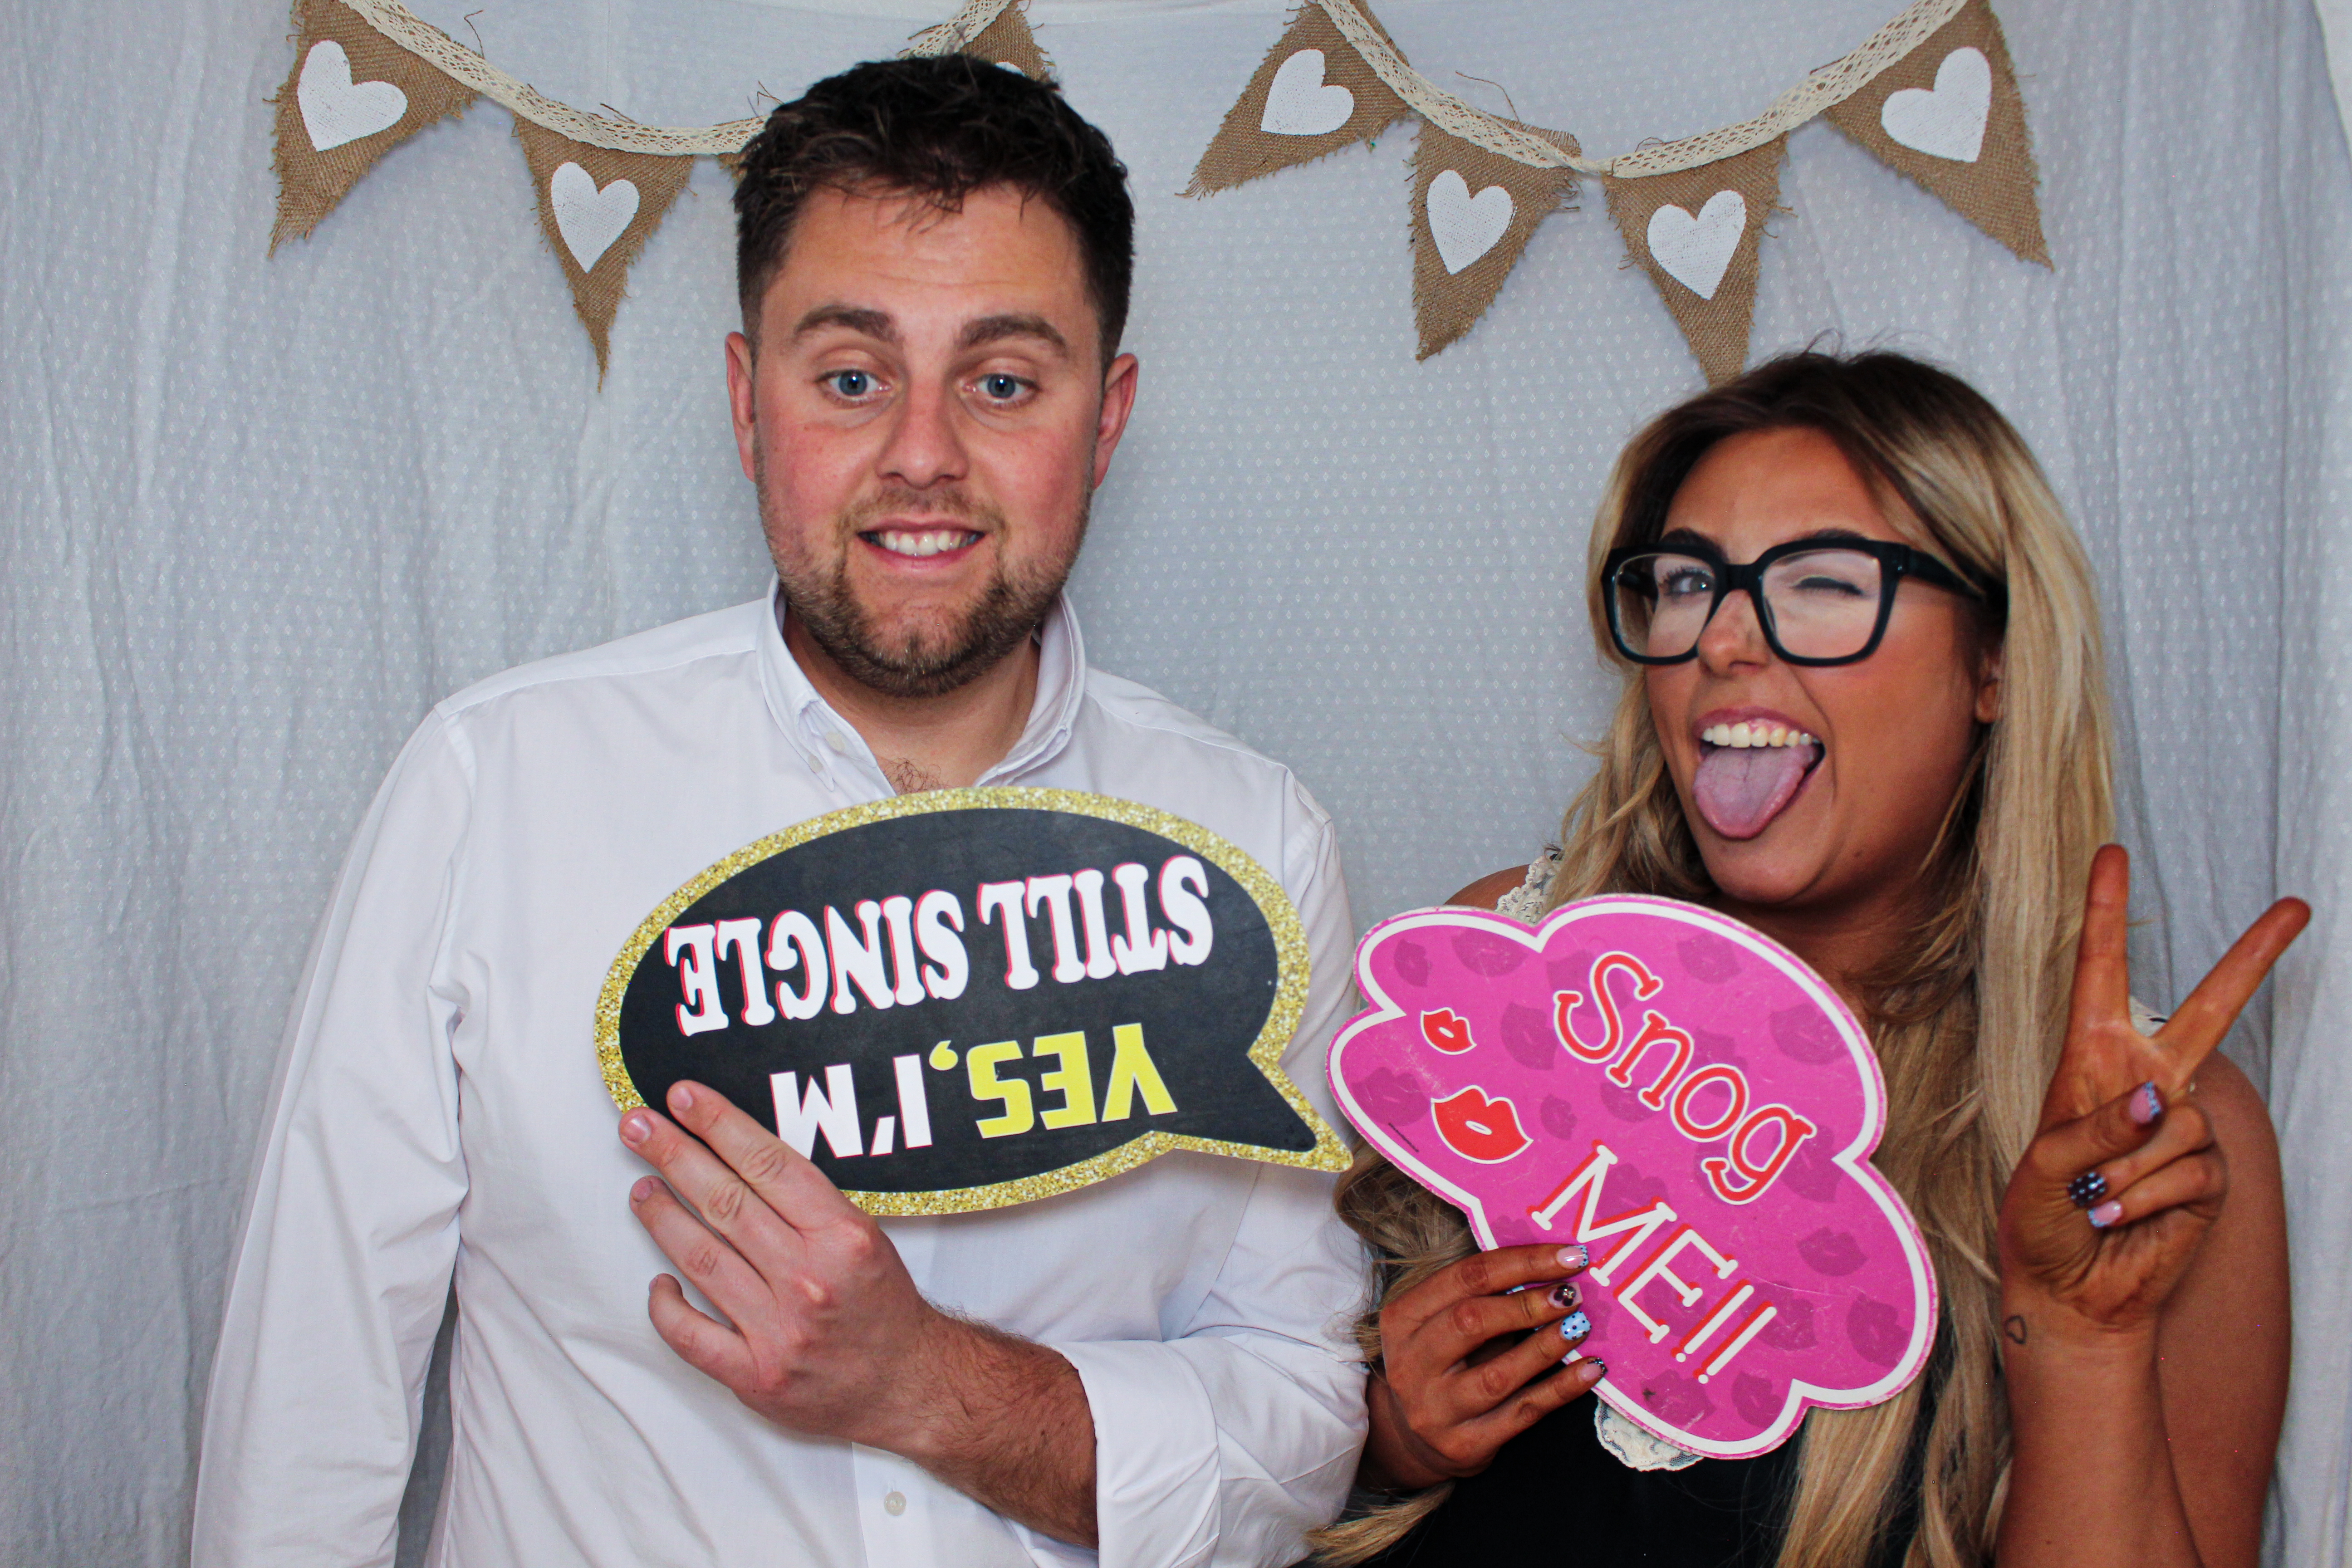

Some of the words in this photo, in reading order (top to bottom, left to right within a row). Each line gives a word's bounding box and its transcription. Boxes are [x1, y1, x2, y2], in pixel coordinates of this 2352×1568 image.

[663, 889, 969, 1037] SINGLE
[977, 855, 1214, 991] STILL
[769, 1054, 933, 1161] I'M
[928, 1023, 1178, 1139] YES,
[1553, 951, 1817, 1205] Snog
[1527, 1139, 1778, 1384] ME!!
